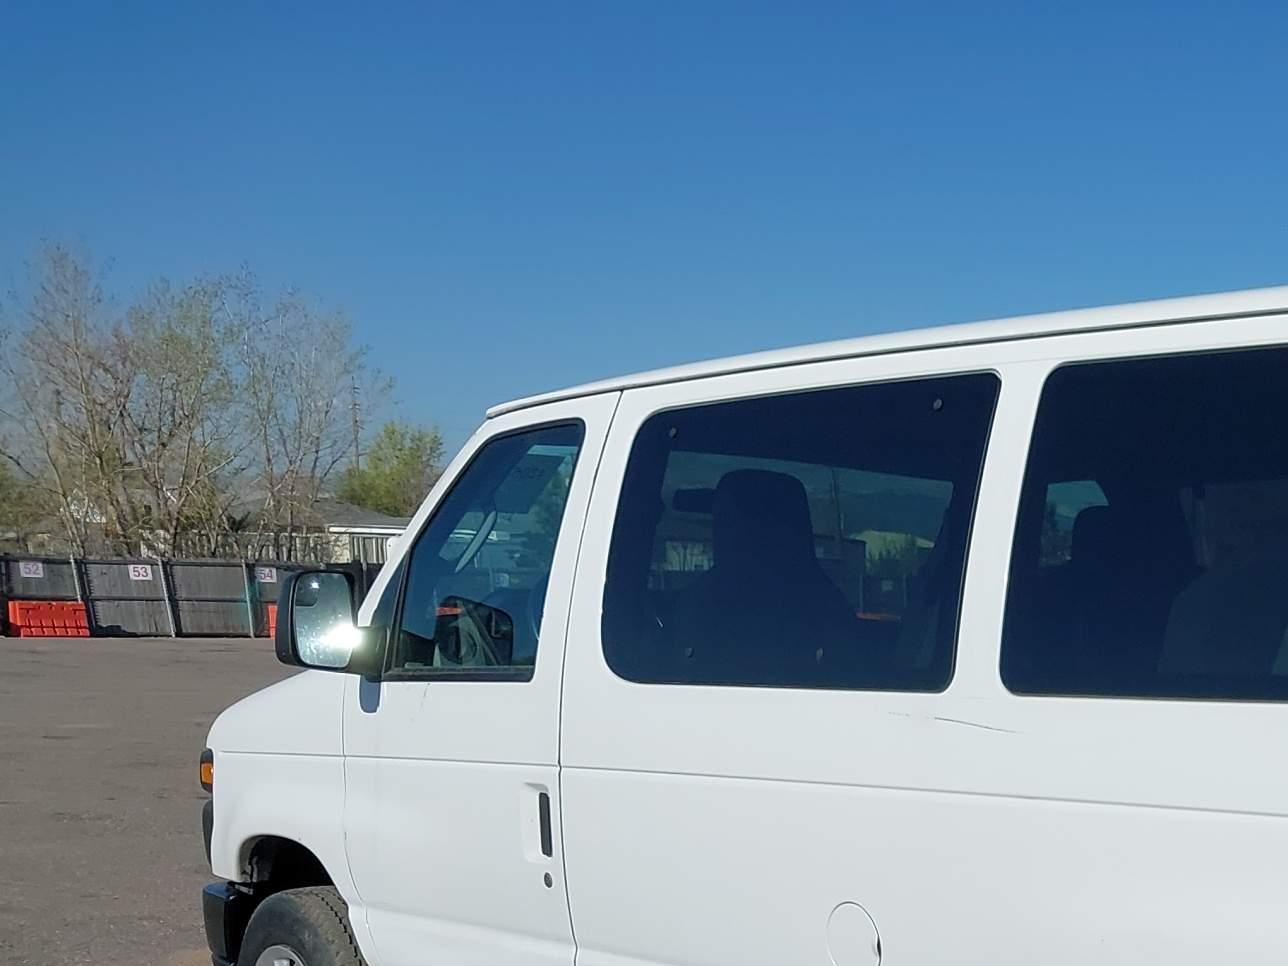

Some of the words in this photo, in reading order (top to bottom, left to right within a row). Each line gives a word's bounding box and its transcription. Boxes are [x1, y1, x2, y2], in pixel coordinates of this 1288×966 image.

[23, 562, 41, 576] 52
[132, 566, 149, 578] 53
[257, 568, 273, 581] 54
